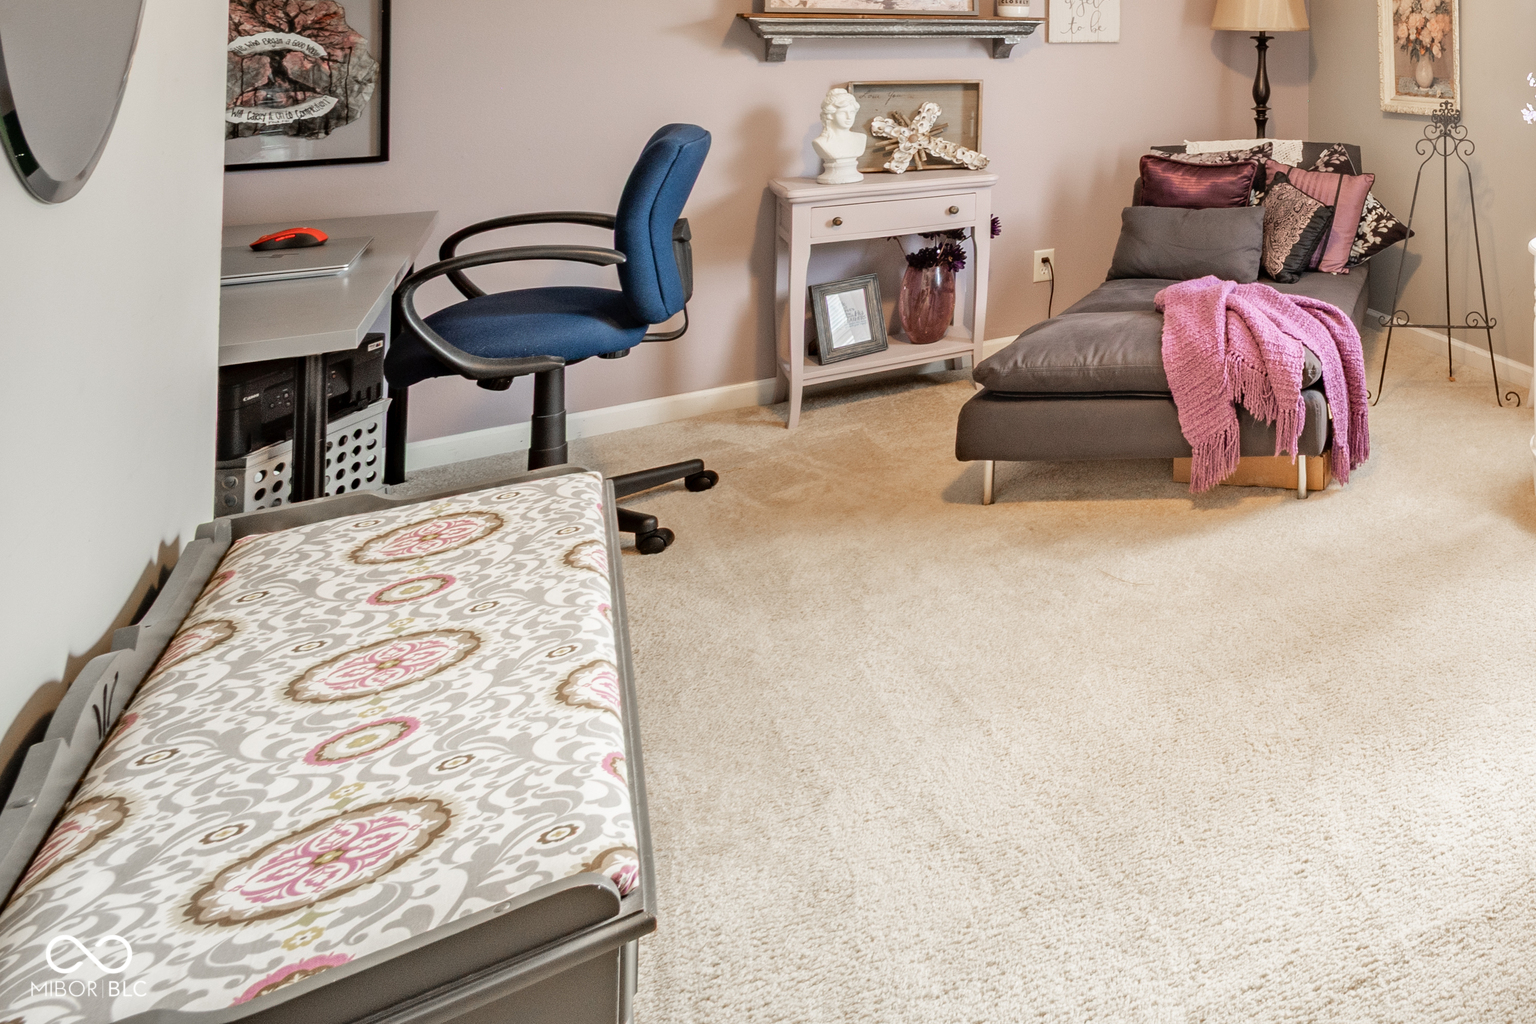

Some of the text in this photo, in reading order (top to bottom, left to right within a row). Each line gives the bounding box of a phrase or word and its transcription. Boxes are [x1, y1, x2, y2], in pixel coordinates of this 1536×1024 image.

[1060, 9, 1107, 35] to be
[242, 392, 260, 402] Canon
